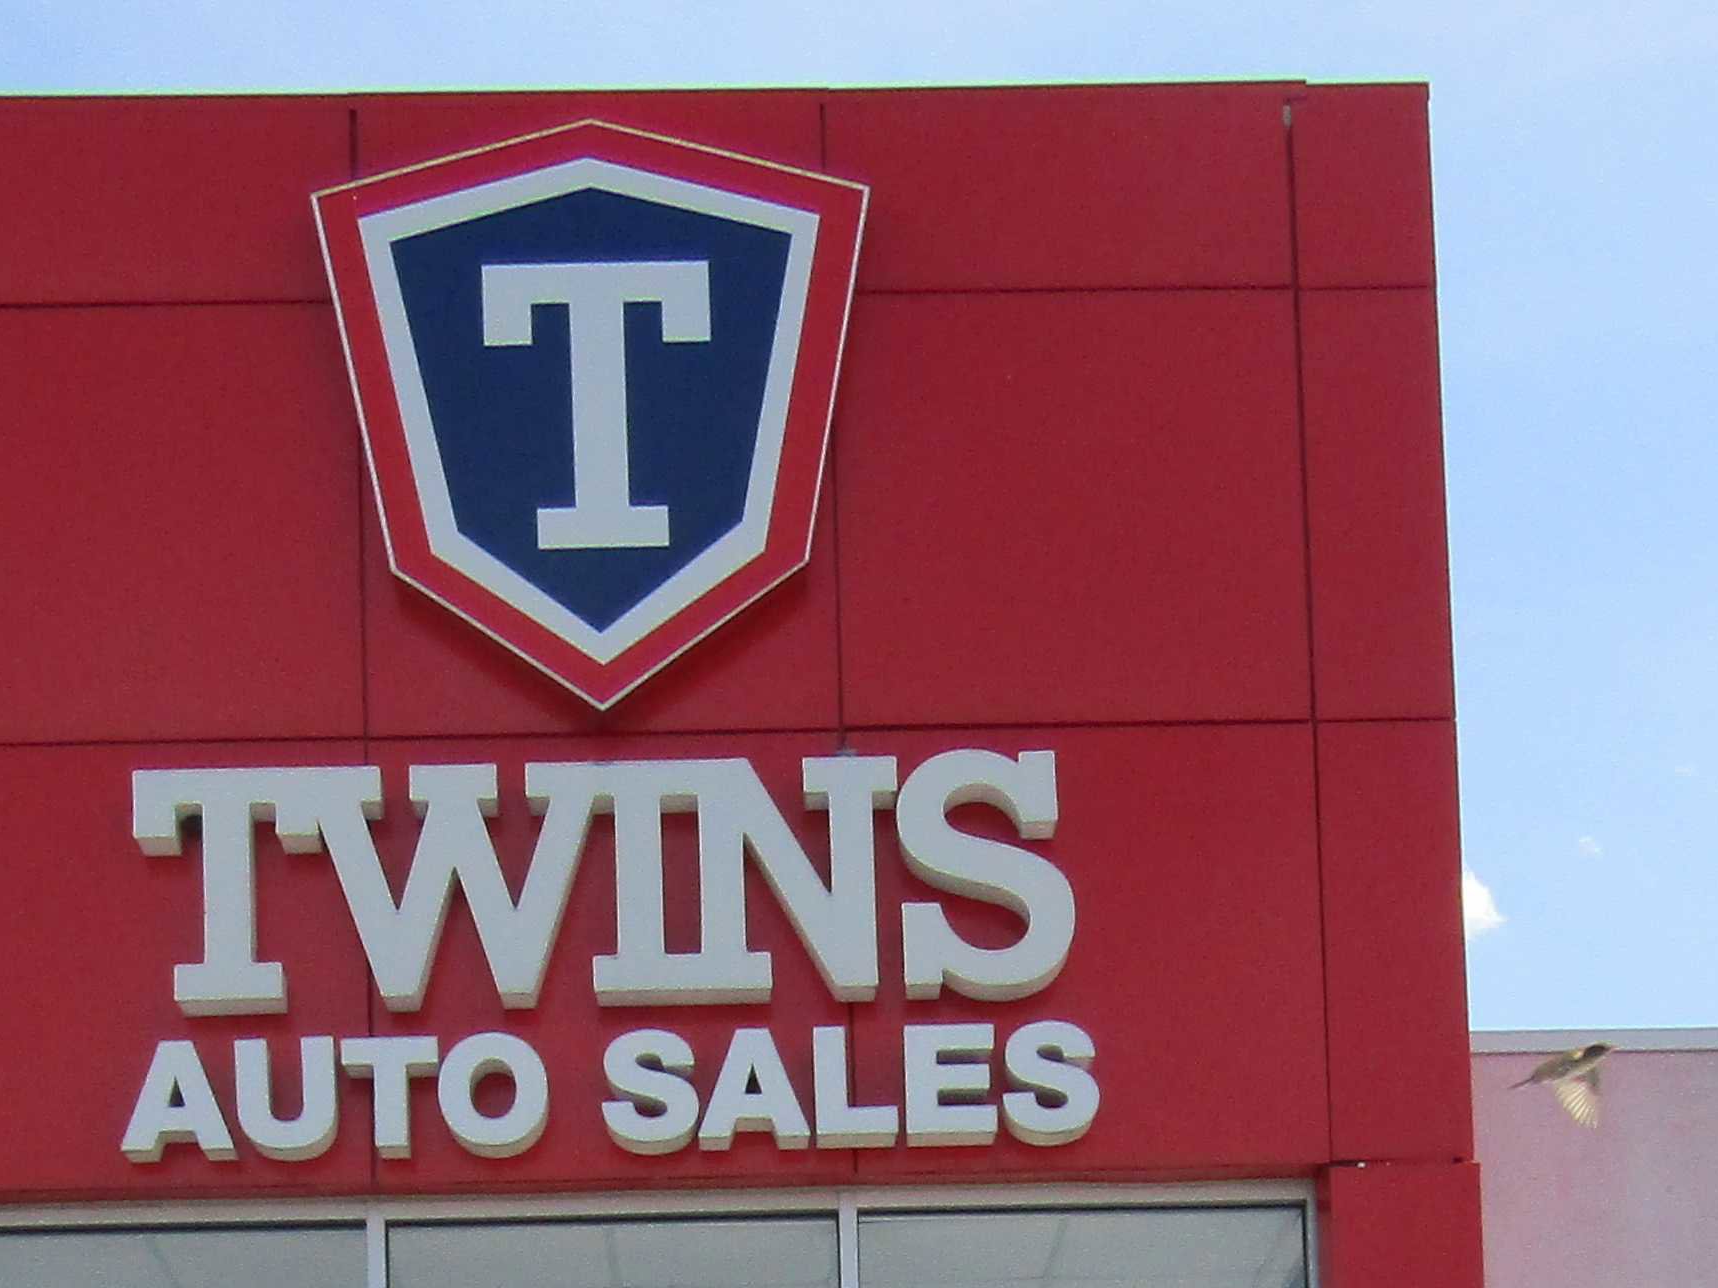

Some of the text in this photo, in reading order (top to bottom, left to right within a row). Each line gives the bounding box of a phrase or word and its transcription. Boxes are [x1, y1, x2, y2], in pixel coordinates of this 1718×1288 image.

[481, 261, 712, 550] T
[132, 748, 1076, 1016] TWINS
[120, 1020, 1101, 1163] AUTO SALES
